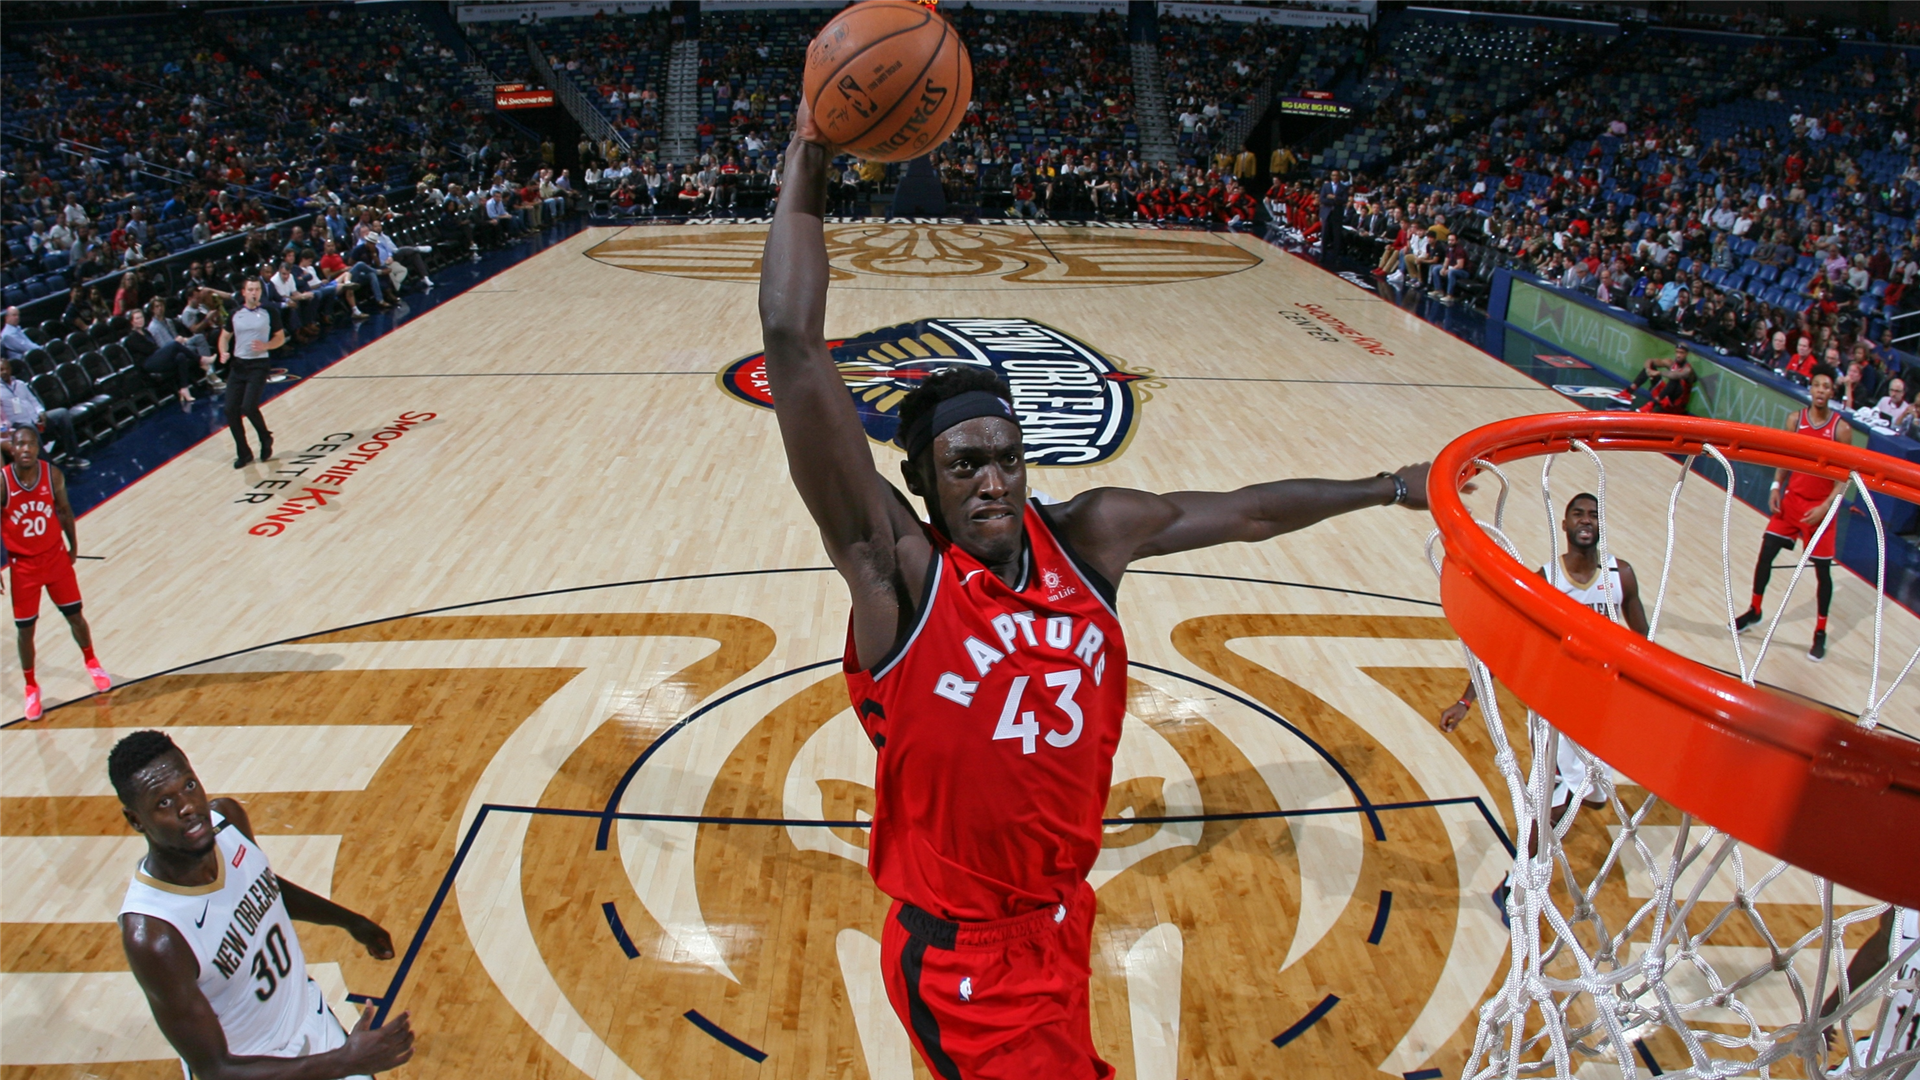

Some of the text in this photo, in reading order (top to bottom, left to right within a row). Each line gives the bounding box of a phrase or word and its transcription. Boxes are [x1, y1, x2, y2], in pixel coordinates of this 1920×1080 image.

[1281, 101, 1293, 109] BIG
[1311, 103, 1323, 111] BIG
[685, 217, 1159, 229] NEW RLEANS PELICANS
[1278, 310, 1340, 342] CENTER
[1294, 302, 1364, 336] SMOOTHIE
[1569, 310, 1633, 370] WAITR
[937, 318, 1105, 464] NEW ORLEANS
[234, 432, 355, 504] CENTER
[312, 410, 437, 486] SMOOTHIE
[22, 516, 47, 538] 20
[1058, 585, 1076, 599] Life
[991, 668, 1084, 755] 43
[212, 866, 282, 981] NEW ORLEANS
[251, 922, 292, 1002] 30
